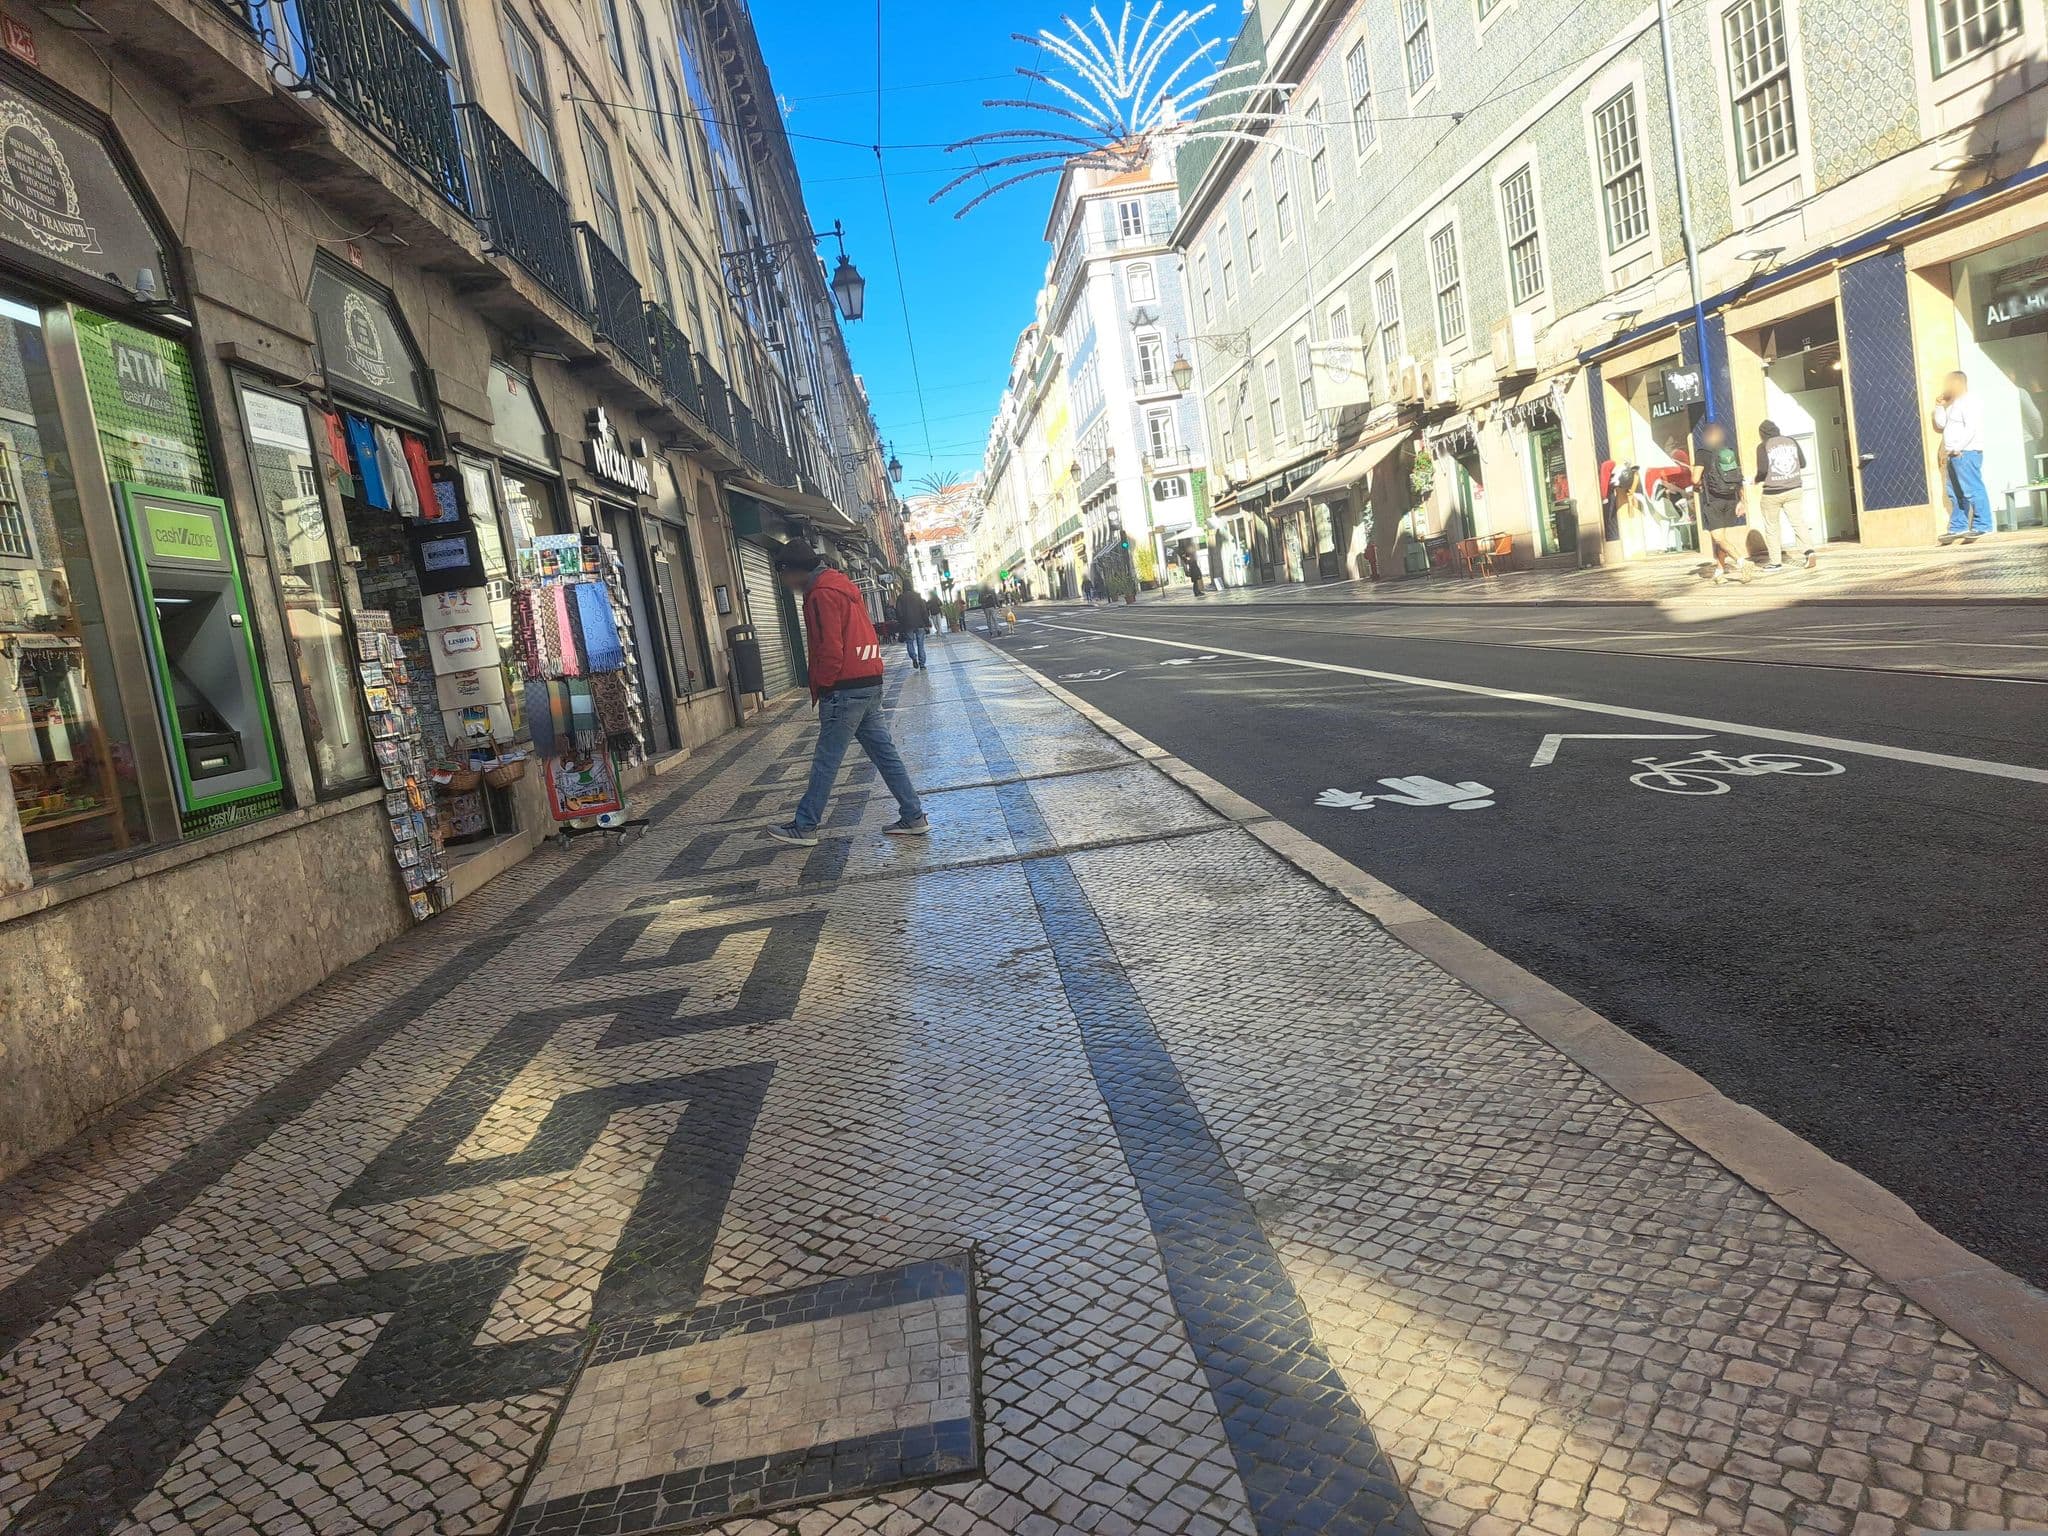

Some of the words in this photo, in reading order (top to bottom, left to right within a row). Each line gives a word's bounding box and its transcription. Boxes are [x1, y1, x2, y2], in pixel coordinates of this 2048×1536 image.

[2, 189, 38, 223] MONEY
[38, 212, 87, 239] TRANSFER
[118, 346, 168, 392] ATM
[592, 436, 651, 496] NICKOLAUS
[448, 637, 475, 646] LISBOA
